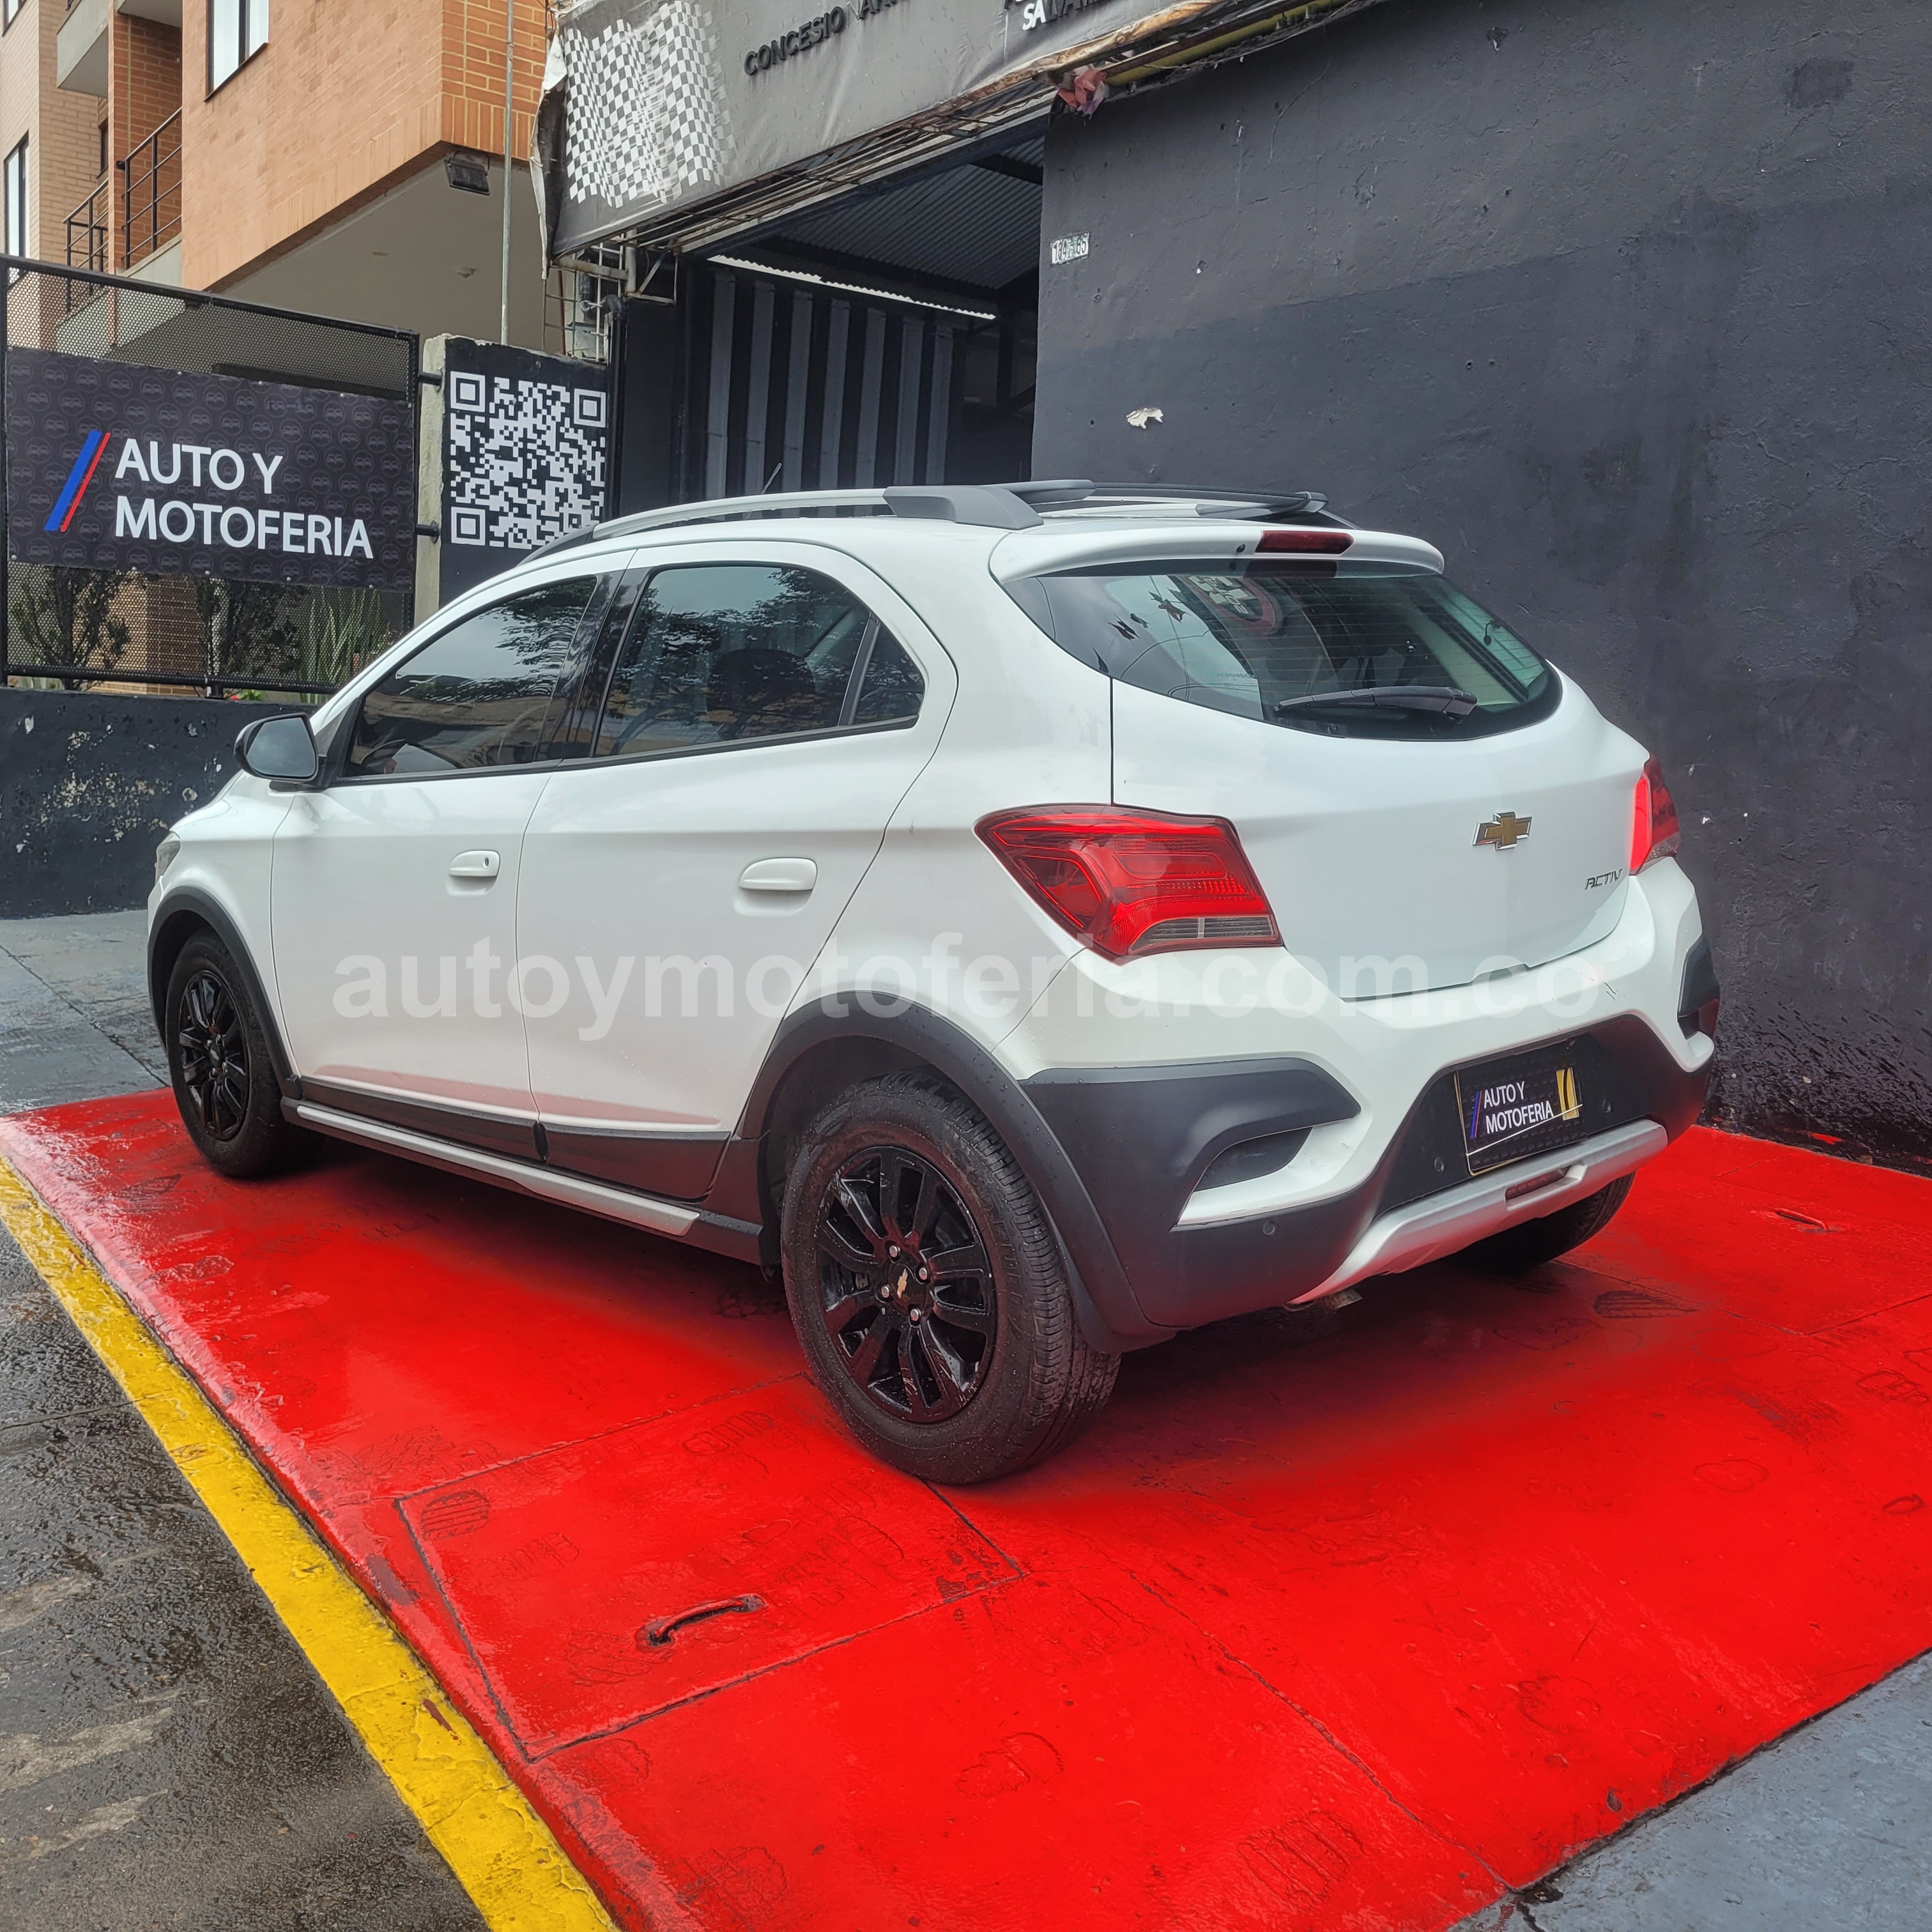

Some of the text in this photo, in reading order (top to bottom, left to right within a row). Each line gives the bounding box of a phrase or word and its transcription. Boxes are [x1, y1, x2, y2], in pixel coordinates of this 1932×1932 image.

[115, 438, 283, 494] AUTO Y
[115, 495, 374, 559] MOTOFERIA
[1584, 868, 1623, 891] ACTIV
[1483, 1080, 1525, 1109] AUTO Y
[1485, 1100, 1554, 1134] MOTOFERIA
